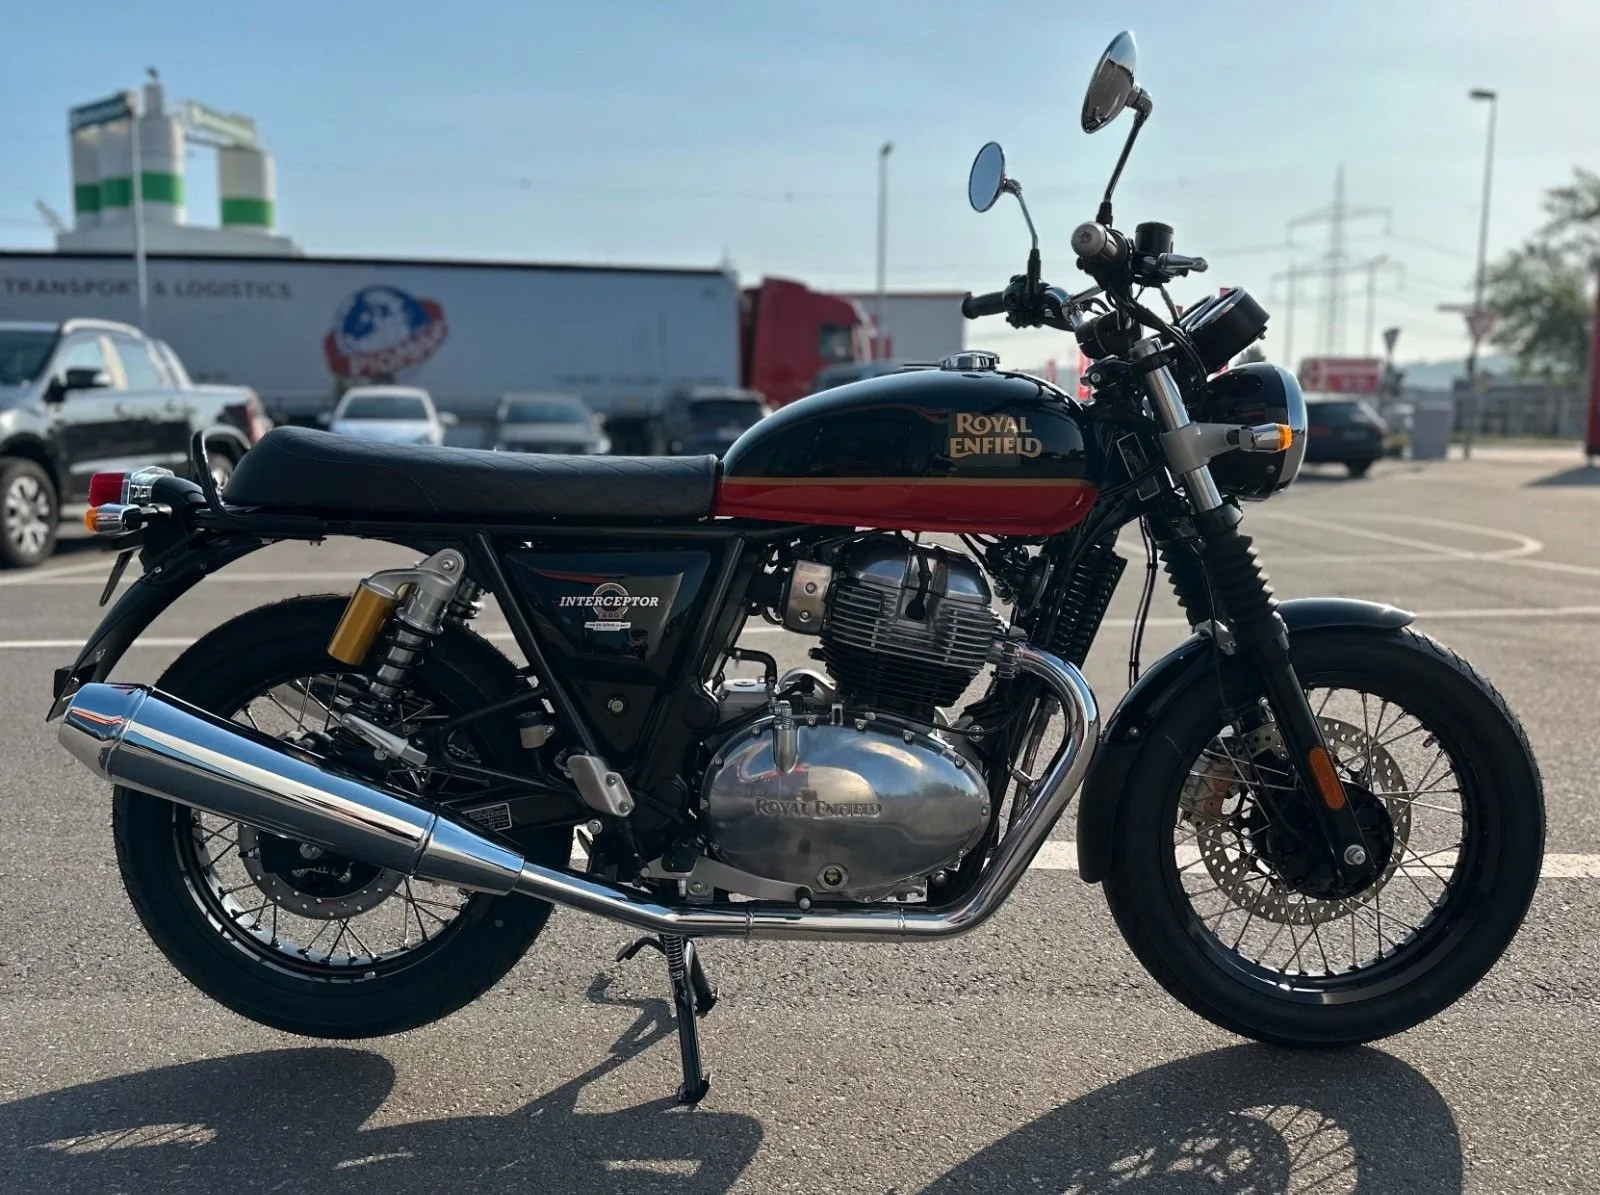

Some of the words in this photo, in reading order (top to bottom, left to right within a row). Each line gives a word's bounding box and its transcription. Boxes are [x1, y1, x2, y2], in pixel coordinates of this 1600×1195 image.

[174, 279, 293, 301] LOGISTICS
[956, 412, 1032, 435] ROYAL
[949, 437, 1043, 458] ENFIELD
[559, 596, 659, 607] INTERCEPTOR
[754, 796, 810, 817] ROYAL
[813, 800, 883, 819] ENFIELD
